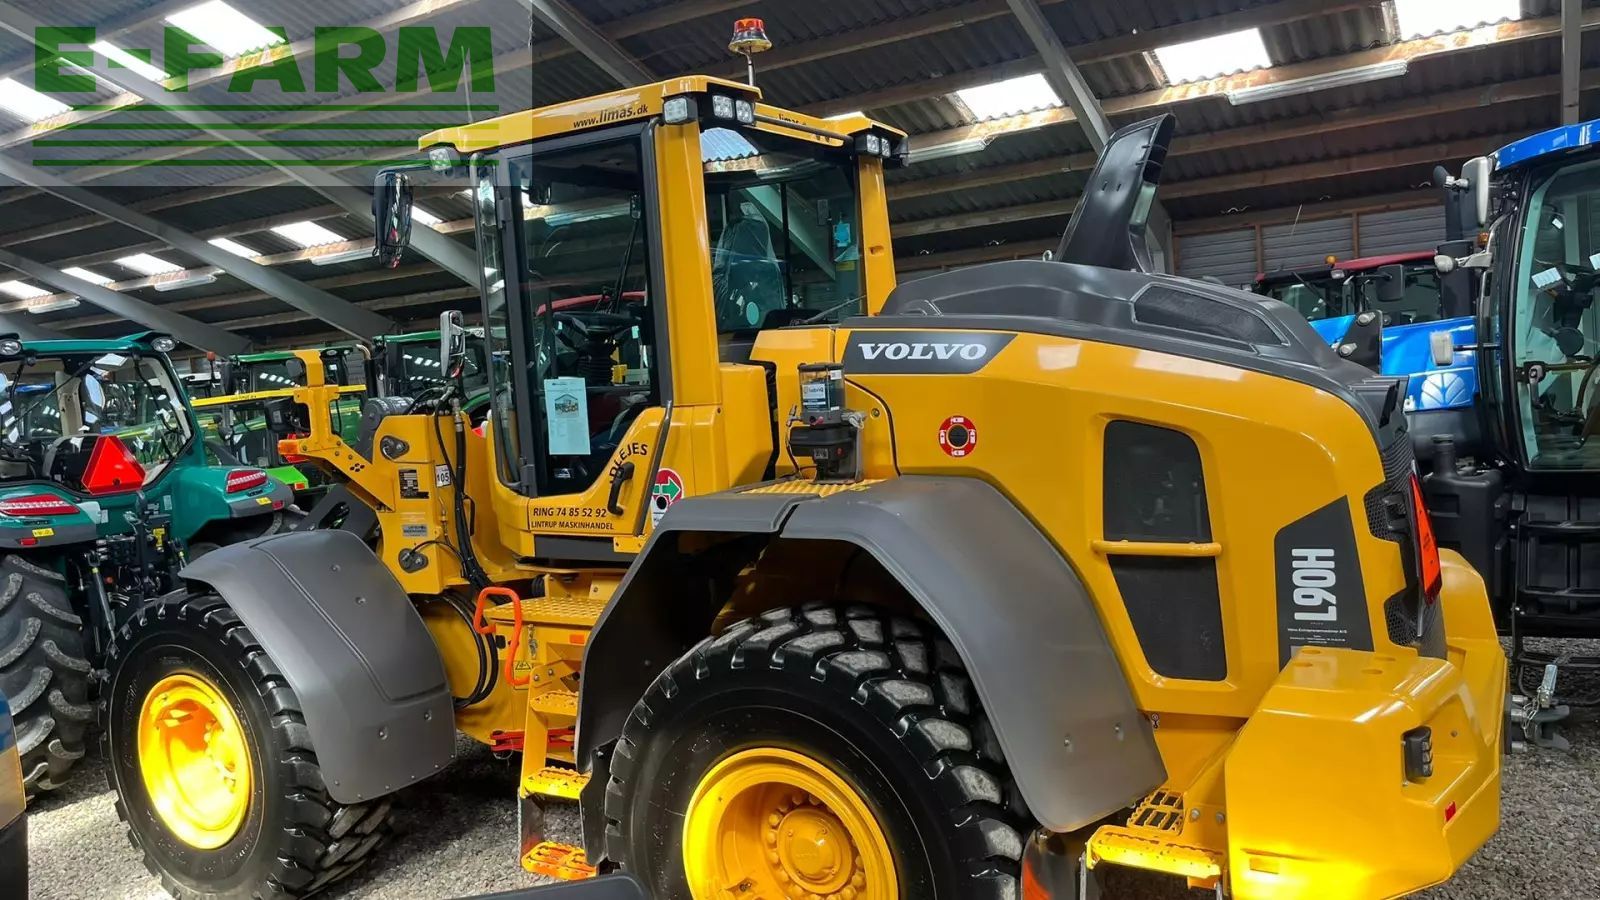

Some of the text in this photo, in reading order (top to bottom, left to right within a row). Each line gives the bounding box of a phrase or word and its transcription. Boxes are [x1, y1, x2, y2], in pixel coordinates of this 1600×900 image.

[573, 104, 648, 128] www.limas.dk
[858, 343, 987, 360] VOLVO
[609, 442, 648, 484] DLEJES
[533, 507, 607, 517] RING 74 85 52 92
[559, 521, 614, 530] MASKINHANDEL
[1291, 548, 1337, 621] L90H
